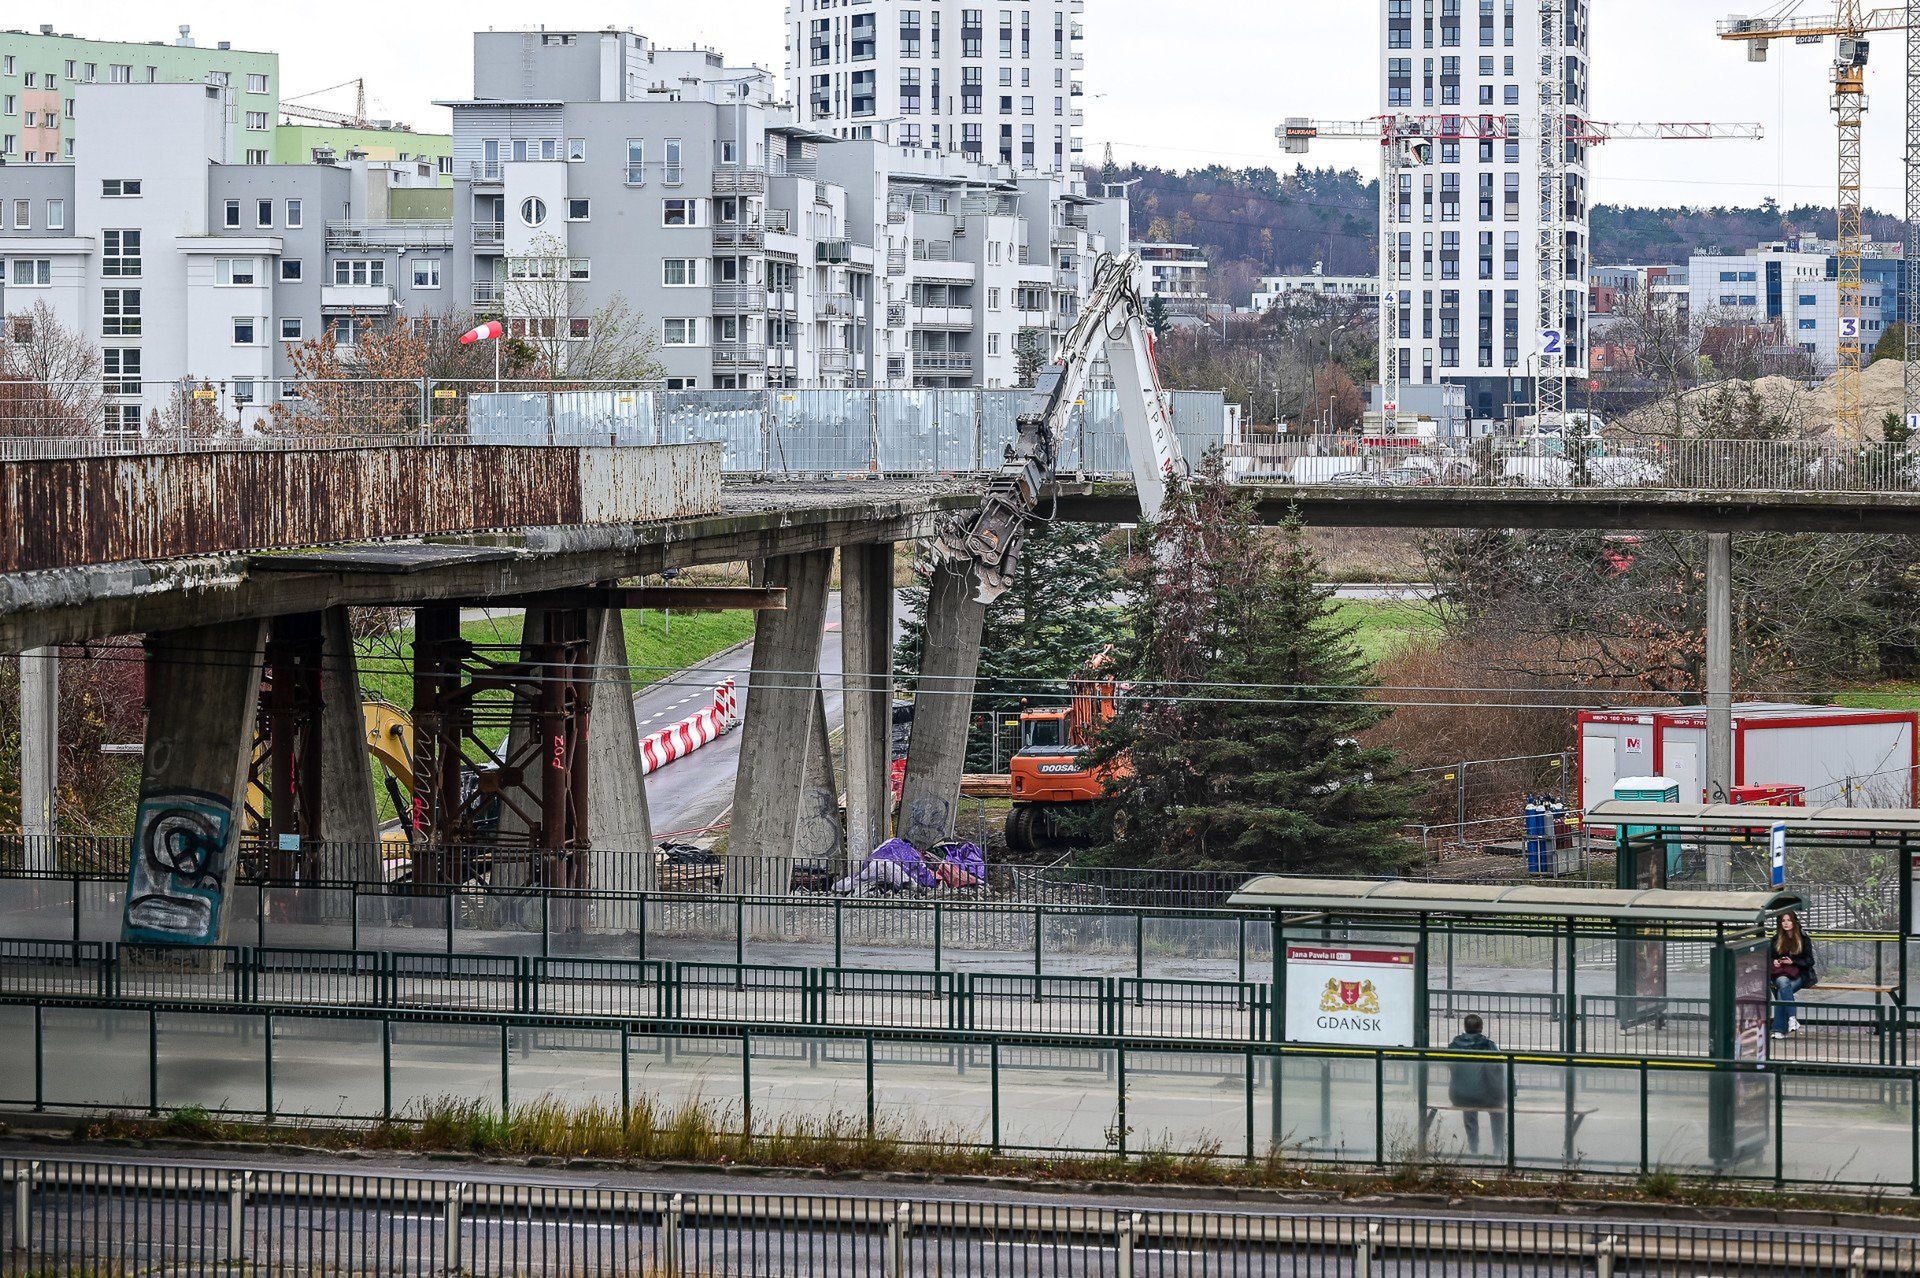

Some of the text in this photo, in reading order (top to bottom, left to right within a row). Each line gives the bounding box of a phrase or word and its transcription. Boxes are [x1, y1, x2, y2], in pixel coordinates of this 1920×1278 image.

[1384, 293, 1394, 302] 4
[1842, 319, 1856, 336] 3
[1543, 330, 1561, 353] 2
[1911, 415, 1917, 428] 1
[1291, 950, 1308, 959] Jana
[1316, 1015, 1382, 1031] GDAŃSK
